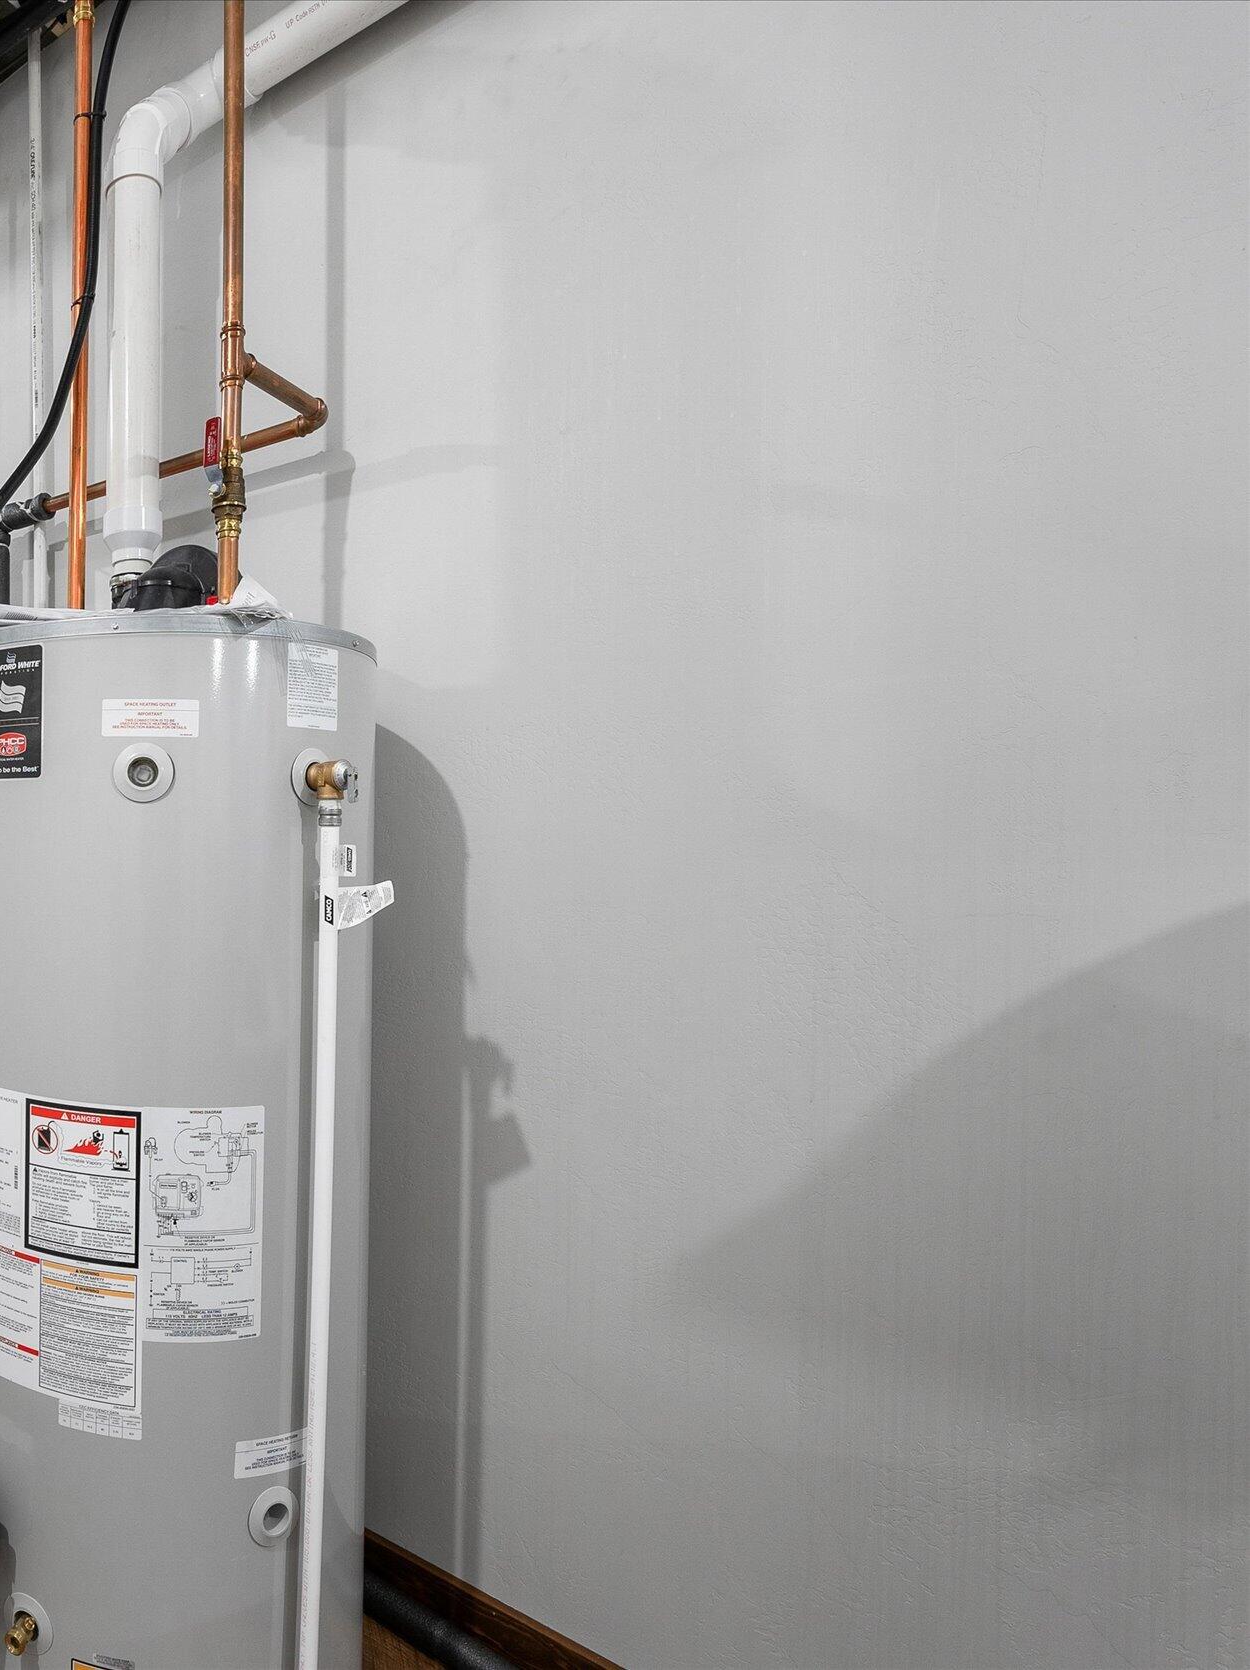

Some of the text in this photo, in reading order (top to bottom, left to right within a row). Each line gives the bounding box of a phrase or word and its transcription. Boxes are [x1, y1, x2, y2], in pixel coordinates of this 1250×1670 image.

[17, 660, 40, 669] WHITE
[71, 1114, 102, 1124] DANGER
[61, 1155, 85, 1164] Flammable
[266, 1446, 288, 1454] IMPORTANT
